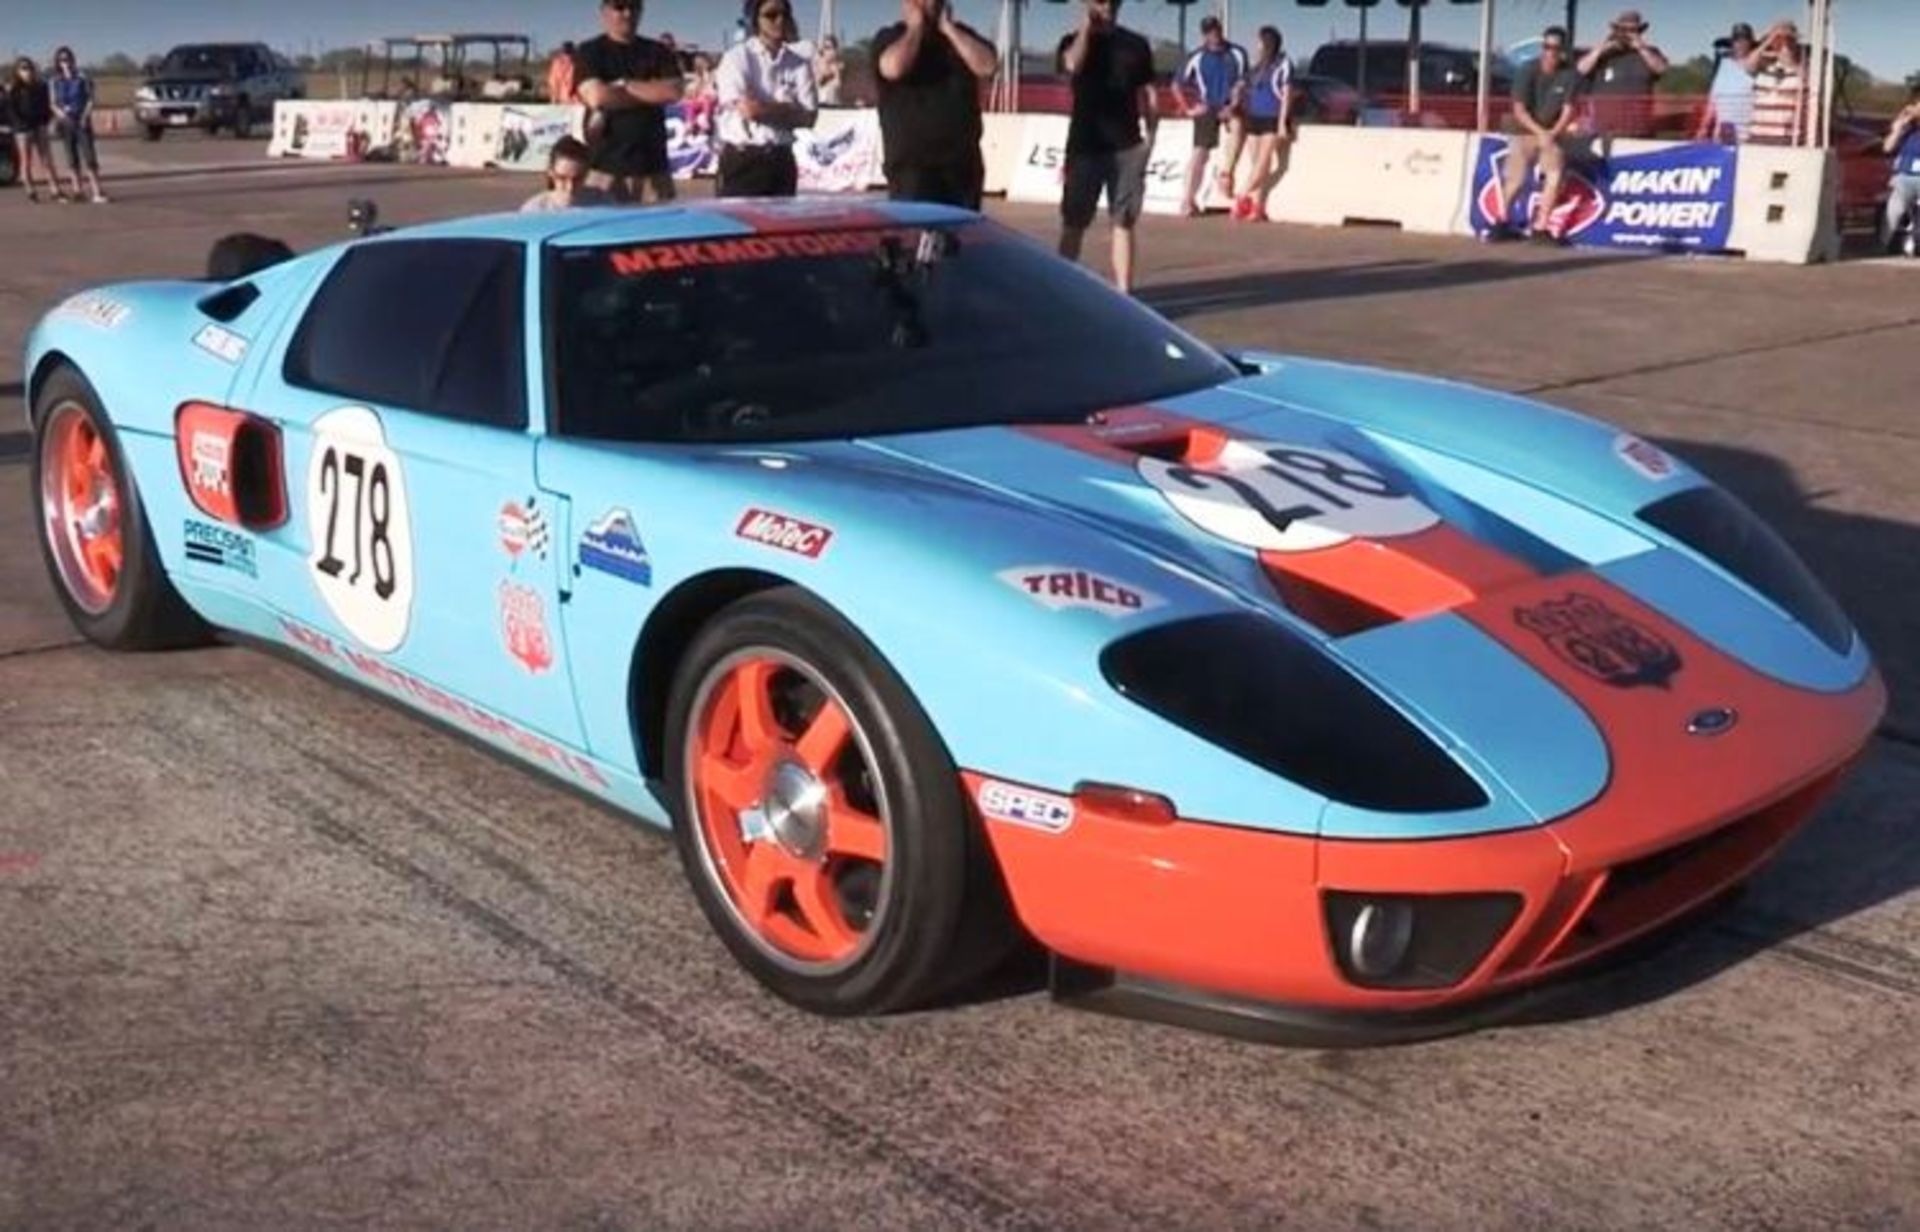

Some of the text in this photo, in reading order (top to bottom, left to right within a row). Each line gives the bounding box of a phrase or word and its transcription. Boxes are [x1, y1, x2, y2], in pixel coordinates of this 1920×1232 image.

[1610, 167, 1721, 194] MAKIN'
[1604, 201, 1724, 228] POWER!
[317, 447, 395, 600] 278
[1023, 571, 1142, 609] TRICO
